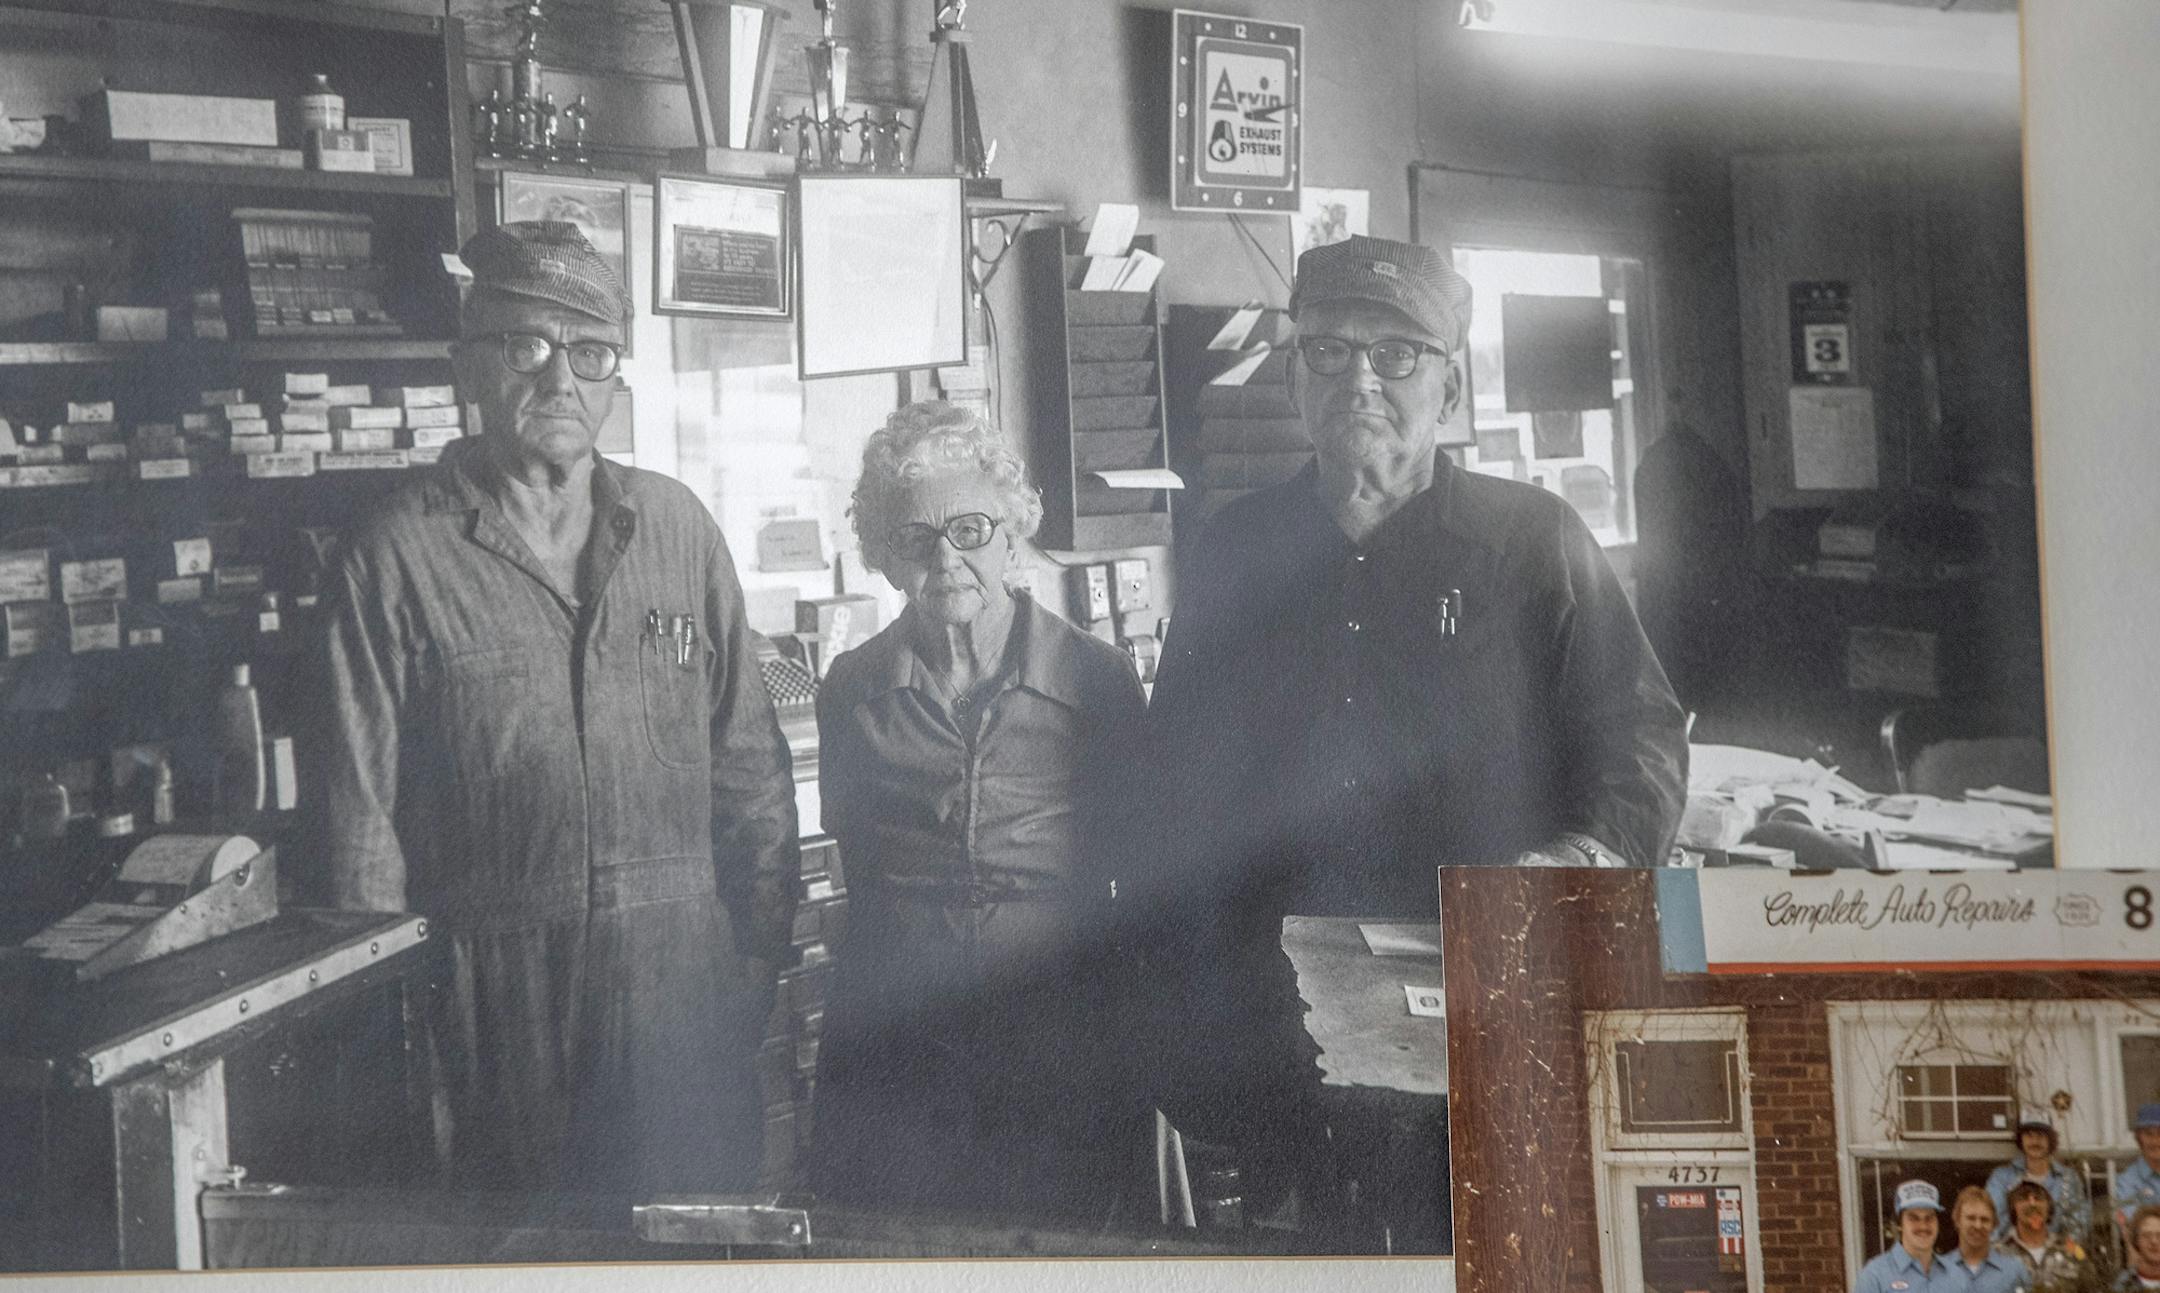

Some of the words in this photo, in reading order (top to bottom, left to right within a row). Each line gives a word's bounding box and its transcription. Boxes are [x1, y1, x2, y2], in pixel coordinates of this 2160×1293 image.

[1235, 24, 1247, 38] 12
[1209, 66, 1282, 112] Arvin
[1239, 126, 1282, 141] EXHAUST
[1239, 142, 1282, 156] SYSTEMS
[1233, 191, 1243, 206] 6
[1764, 887, 1868, 934] Complete
[1861, 883, 1936, 930] Auto
[1938, 882, 2035, 931] Repairs
[2124, 885, 2153, 931] 8
[1668, 1166, 1720, 1183] 4737
